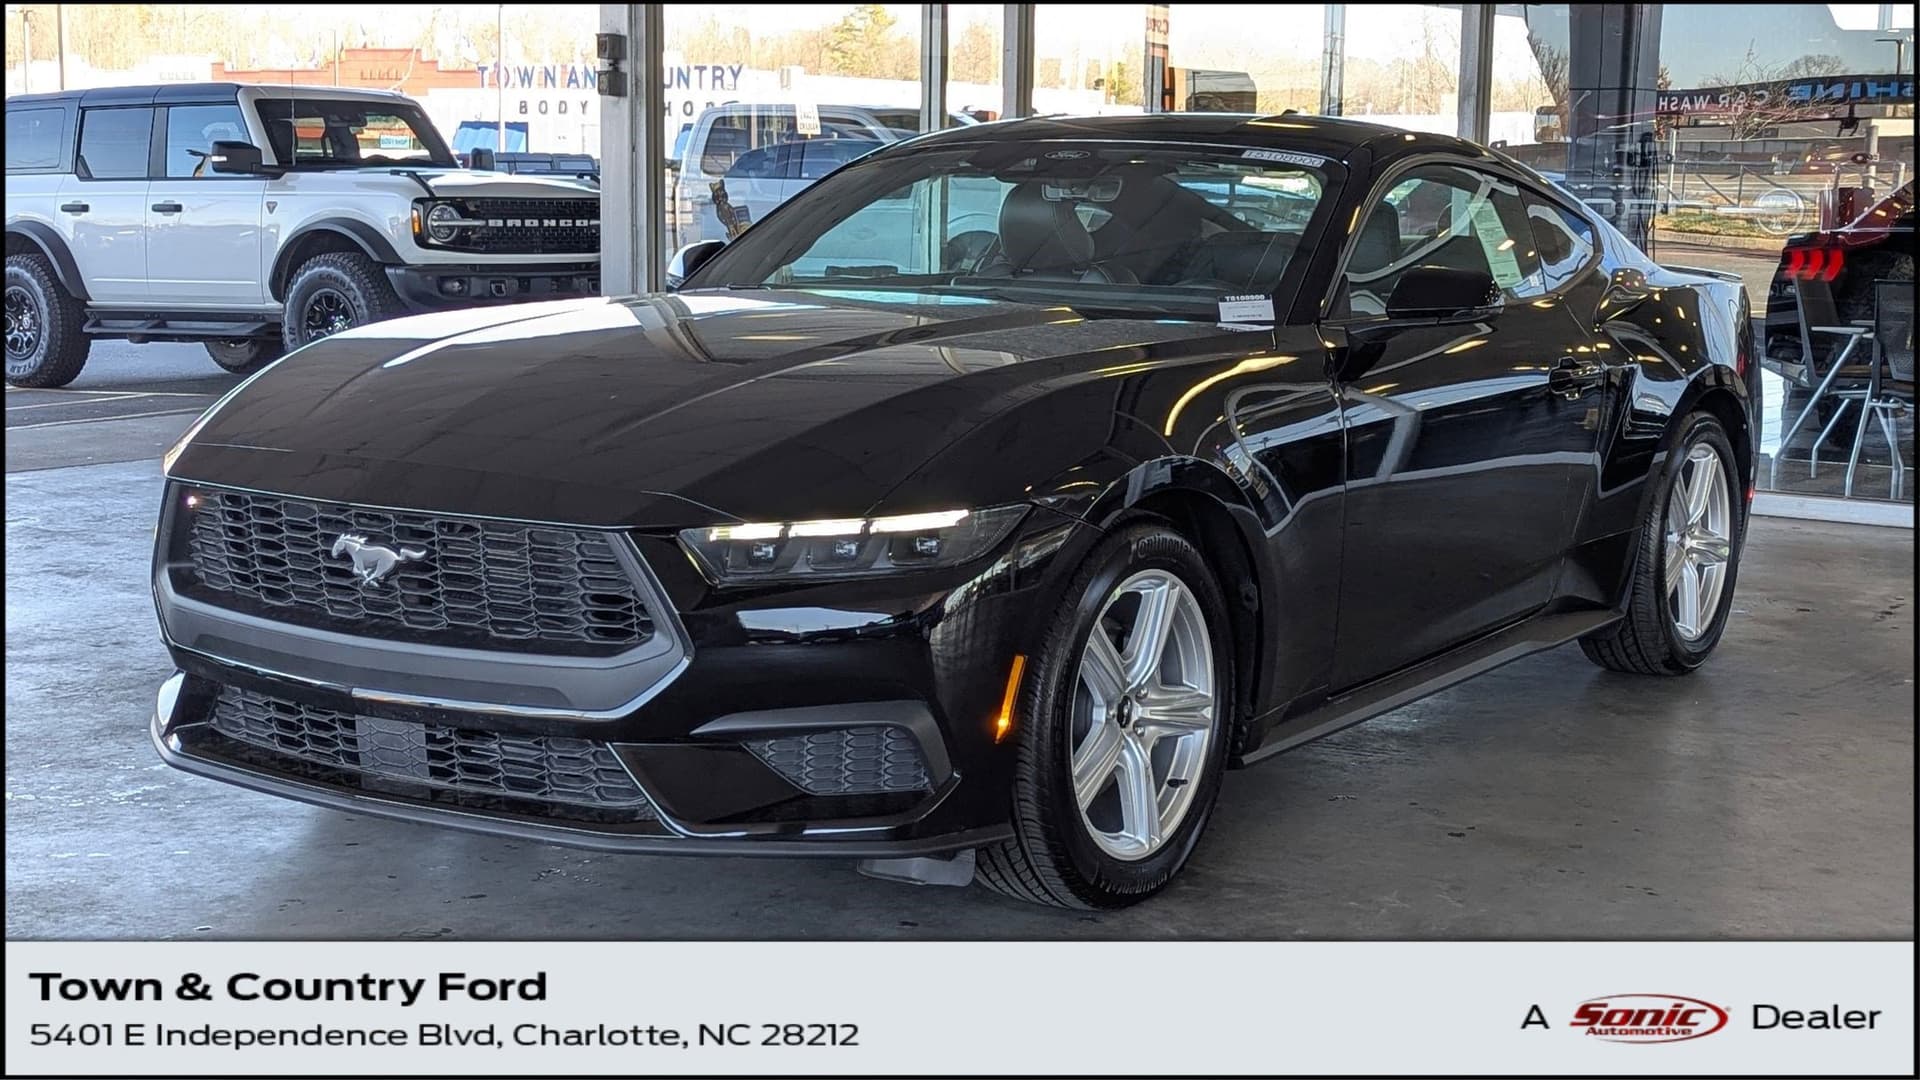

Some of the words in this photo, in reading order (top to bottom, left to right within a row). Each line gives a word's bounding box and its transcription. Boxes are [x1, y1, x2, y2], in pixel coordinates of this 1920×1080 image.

[478, 65, 556, 89] TOWN
[519, 100, 589, 116] BODY
[488, 219, 589, 227] BRONCO
